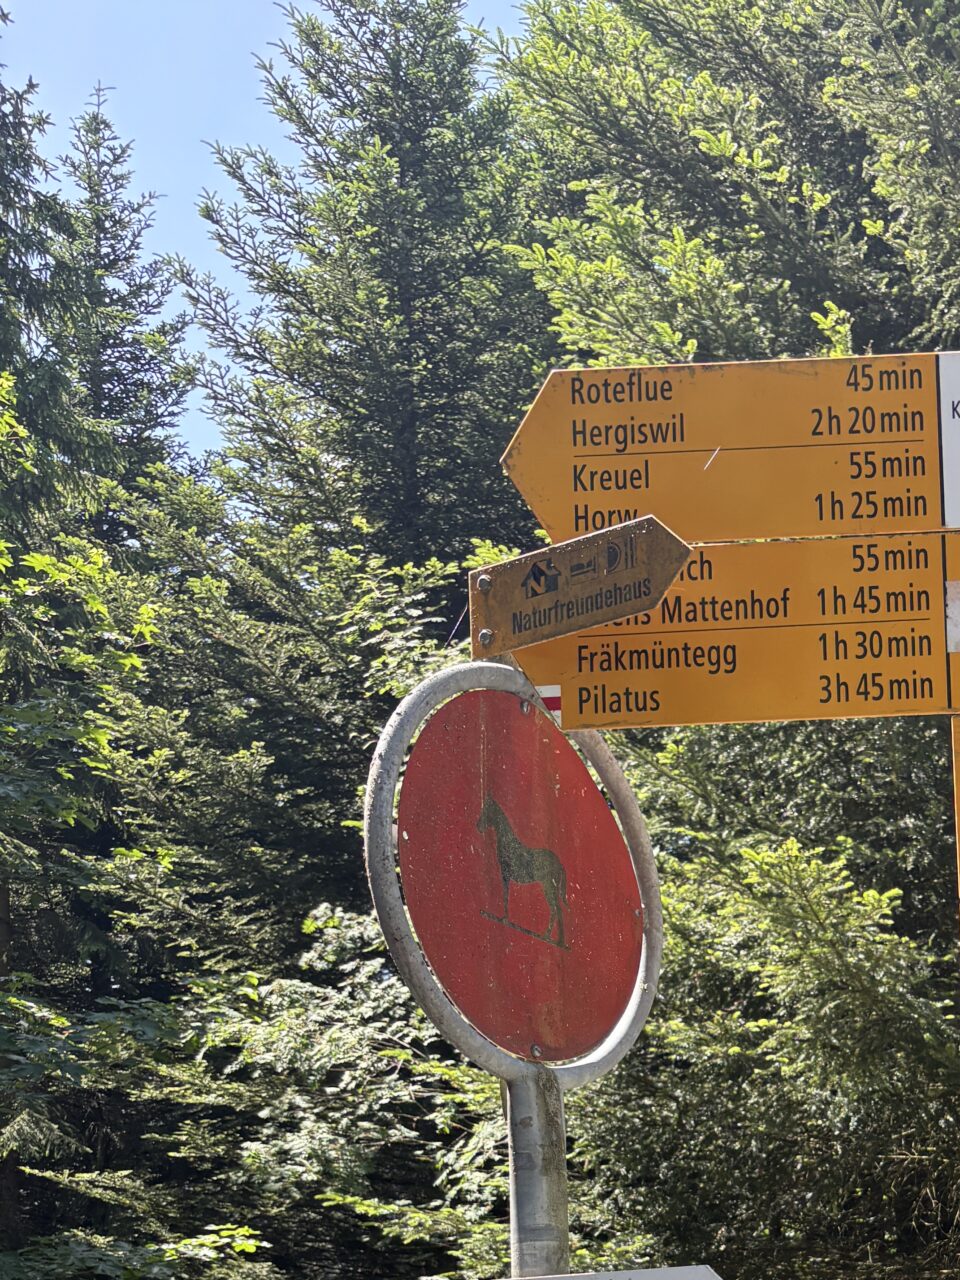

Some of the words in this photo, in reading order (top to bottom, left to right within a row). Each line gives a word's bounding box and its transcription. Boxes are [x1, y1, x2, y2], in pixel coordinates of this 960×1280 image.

[571, 371, 673, 404] Roteflue
[572, 414, 686, 452] Hergiswil
[573, 462, 650, 493] Kreuel
[512, 577, 651, 635] Naturfreundehaus
[661, 588, 790, 624] Mattenhof
[578, 642, 737, 674] Fräkmüntegg
[578, 686, 661, 714] Pilatus
